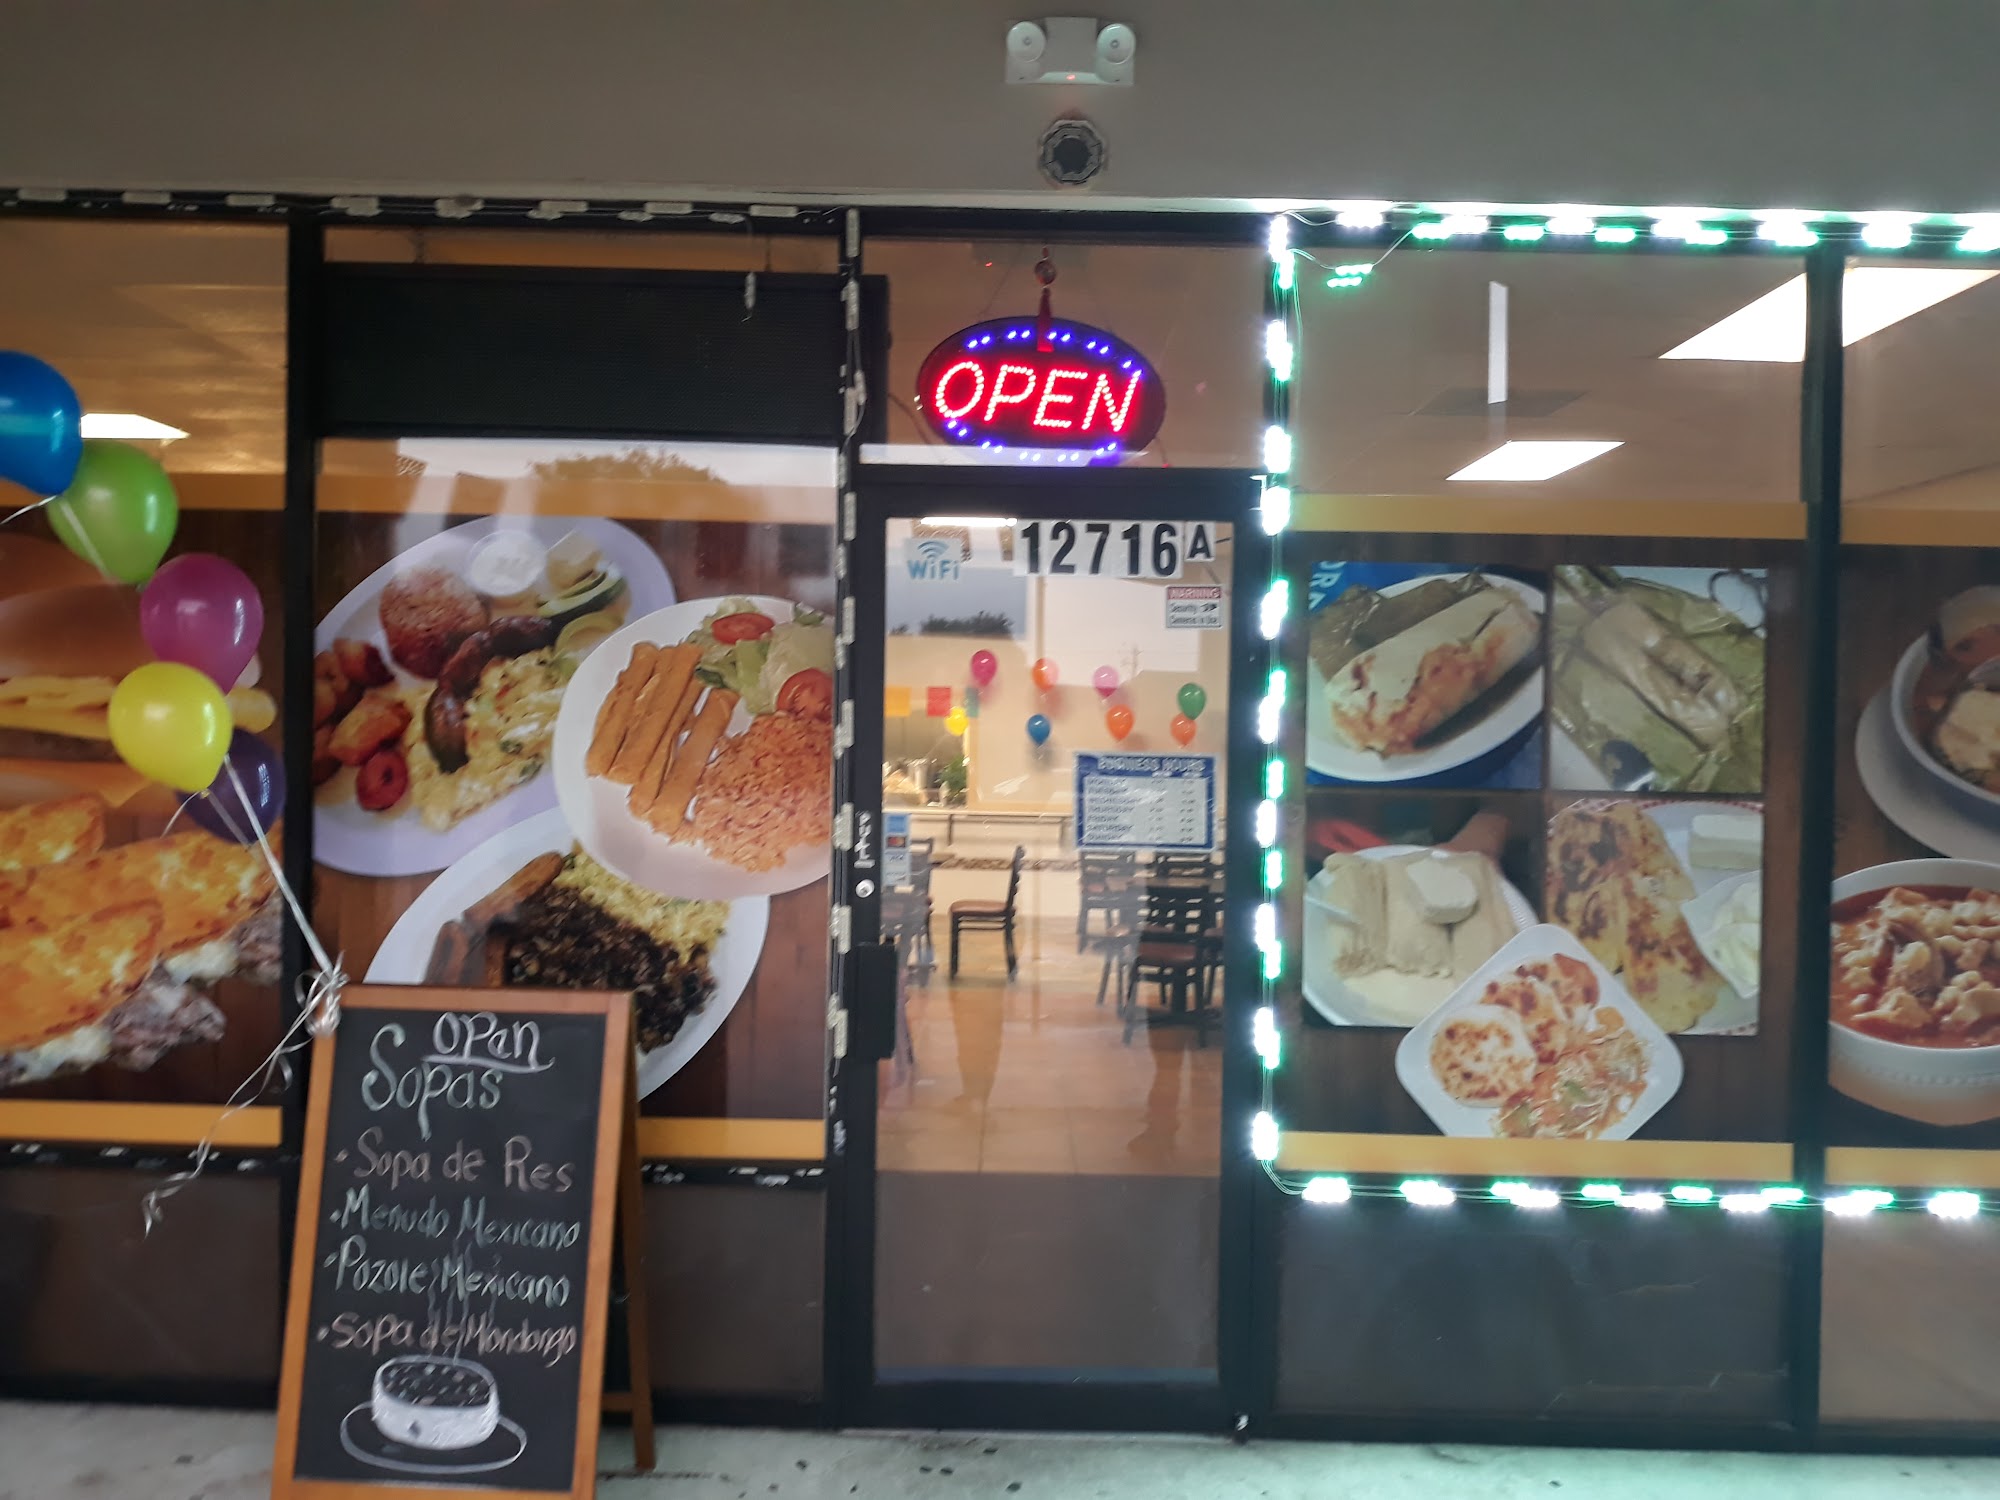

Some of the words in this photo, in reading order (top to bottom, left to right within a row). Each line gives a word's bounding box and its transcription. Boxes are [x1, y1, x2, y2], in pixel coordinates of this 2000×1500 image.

[935, 361, 1142, 432] OPEN
[1021, 521, 1178, 576] 12716
[1189, 524, 1211, 560] A
[361, 1023, 503, 1141] Sopas
[353, 1126, 432, 1190] Sopa
[443, 1139, 486, 1182] de
[504, 1135, 576, 1192] Res
[340, 1183, 449, 1238] Menudo
[456, 1196, 581, 1251] Mexicano
[441, 1252, 571, 1308] Mexicano
[331, 1312, 415, 1355] Sopa
